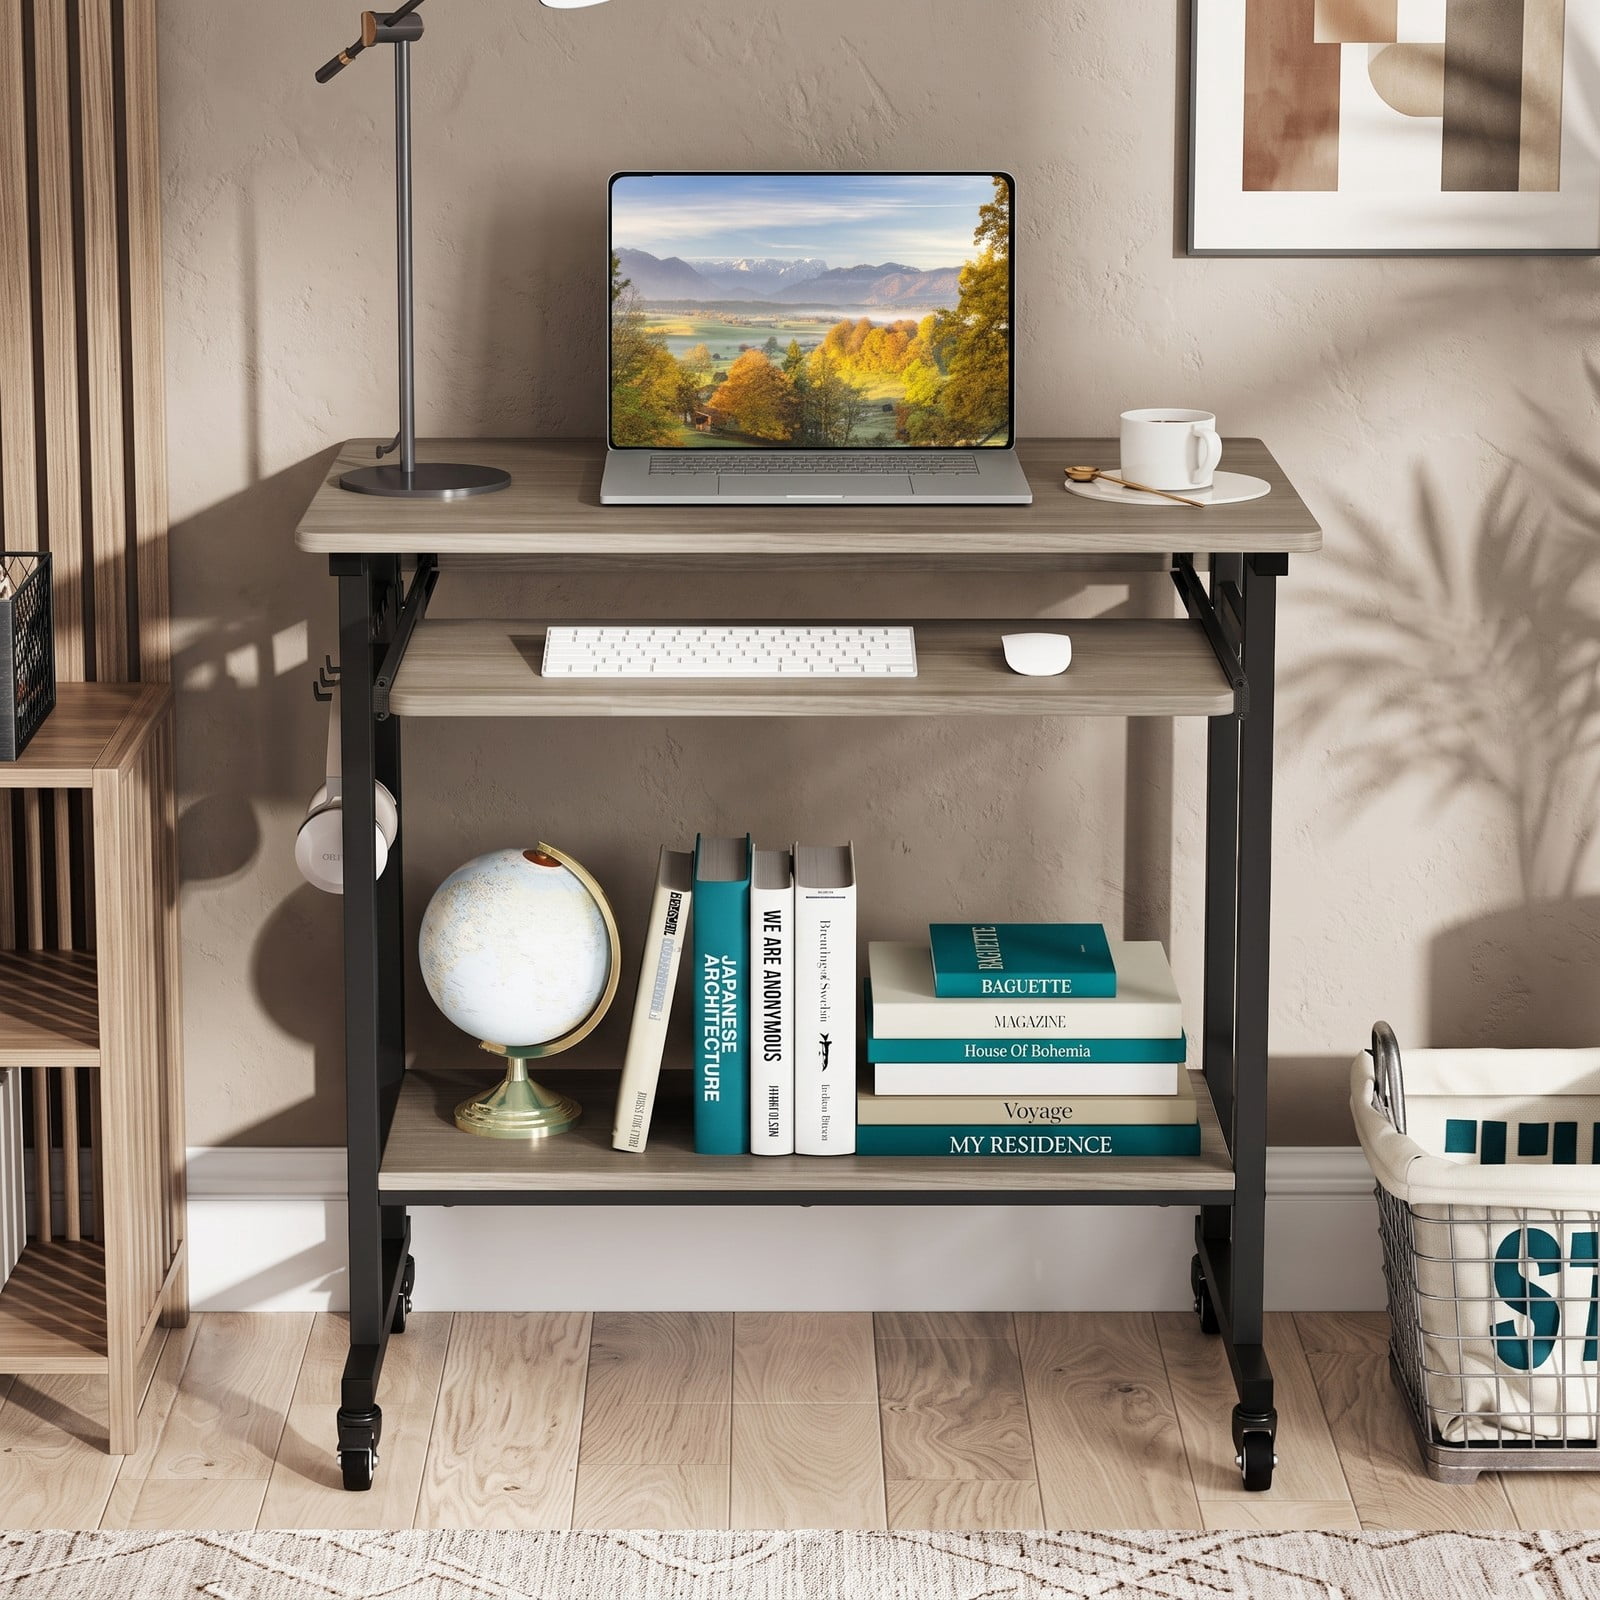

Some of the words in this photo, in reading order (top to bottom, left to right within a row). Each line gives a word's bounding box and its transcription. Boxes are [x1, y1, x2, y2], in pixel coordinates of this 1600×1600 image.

[763, 909, 782, 933] WE
[763, 936, 782, 966] ARE
[972, 926, 1004, 970] BAGUETTE
[981, 979, 1072, 994] BAGUETTE
[721, 954, 738, 1054] JAPANESE
[763, 969, 782, 1062] ANONYMOUS
[703, 953, 721, 1102] ARCHITECTURE
[994, 1015, 1066, 1029] MAGAZINE
[964, 1044, 1008, 1058] House
[1010, 1044, 1029, 1058] Of
[1031, 1044, 1091, 1058] Bohemia
[1004, 1102, 1073, 1124] Voyage
[949, 1136, 985, 1154] MY
[989, 1136, 1112, 1154] RESIDENCE
